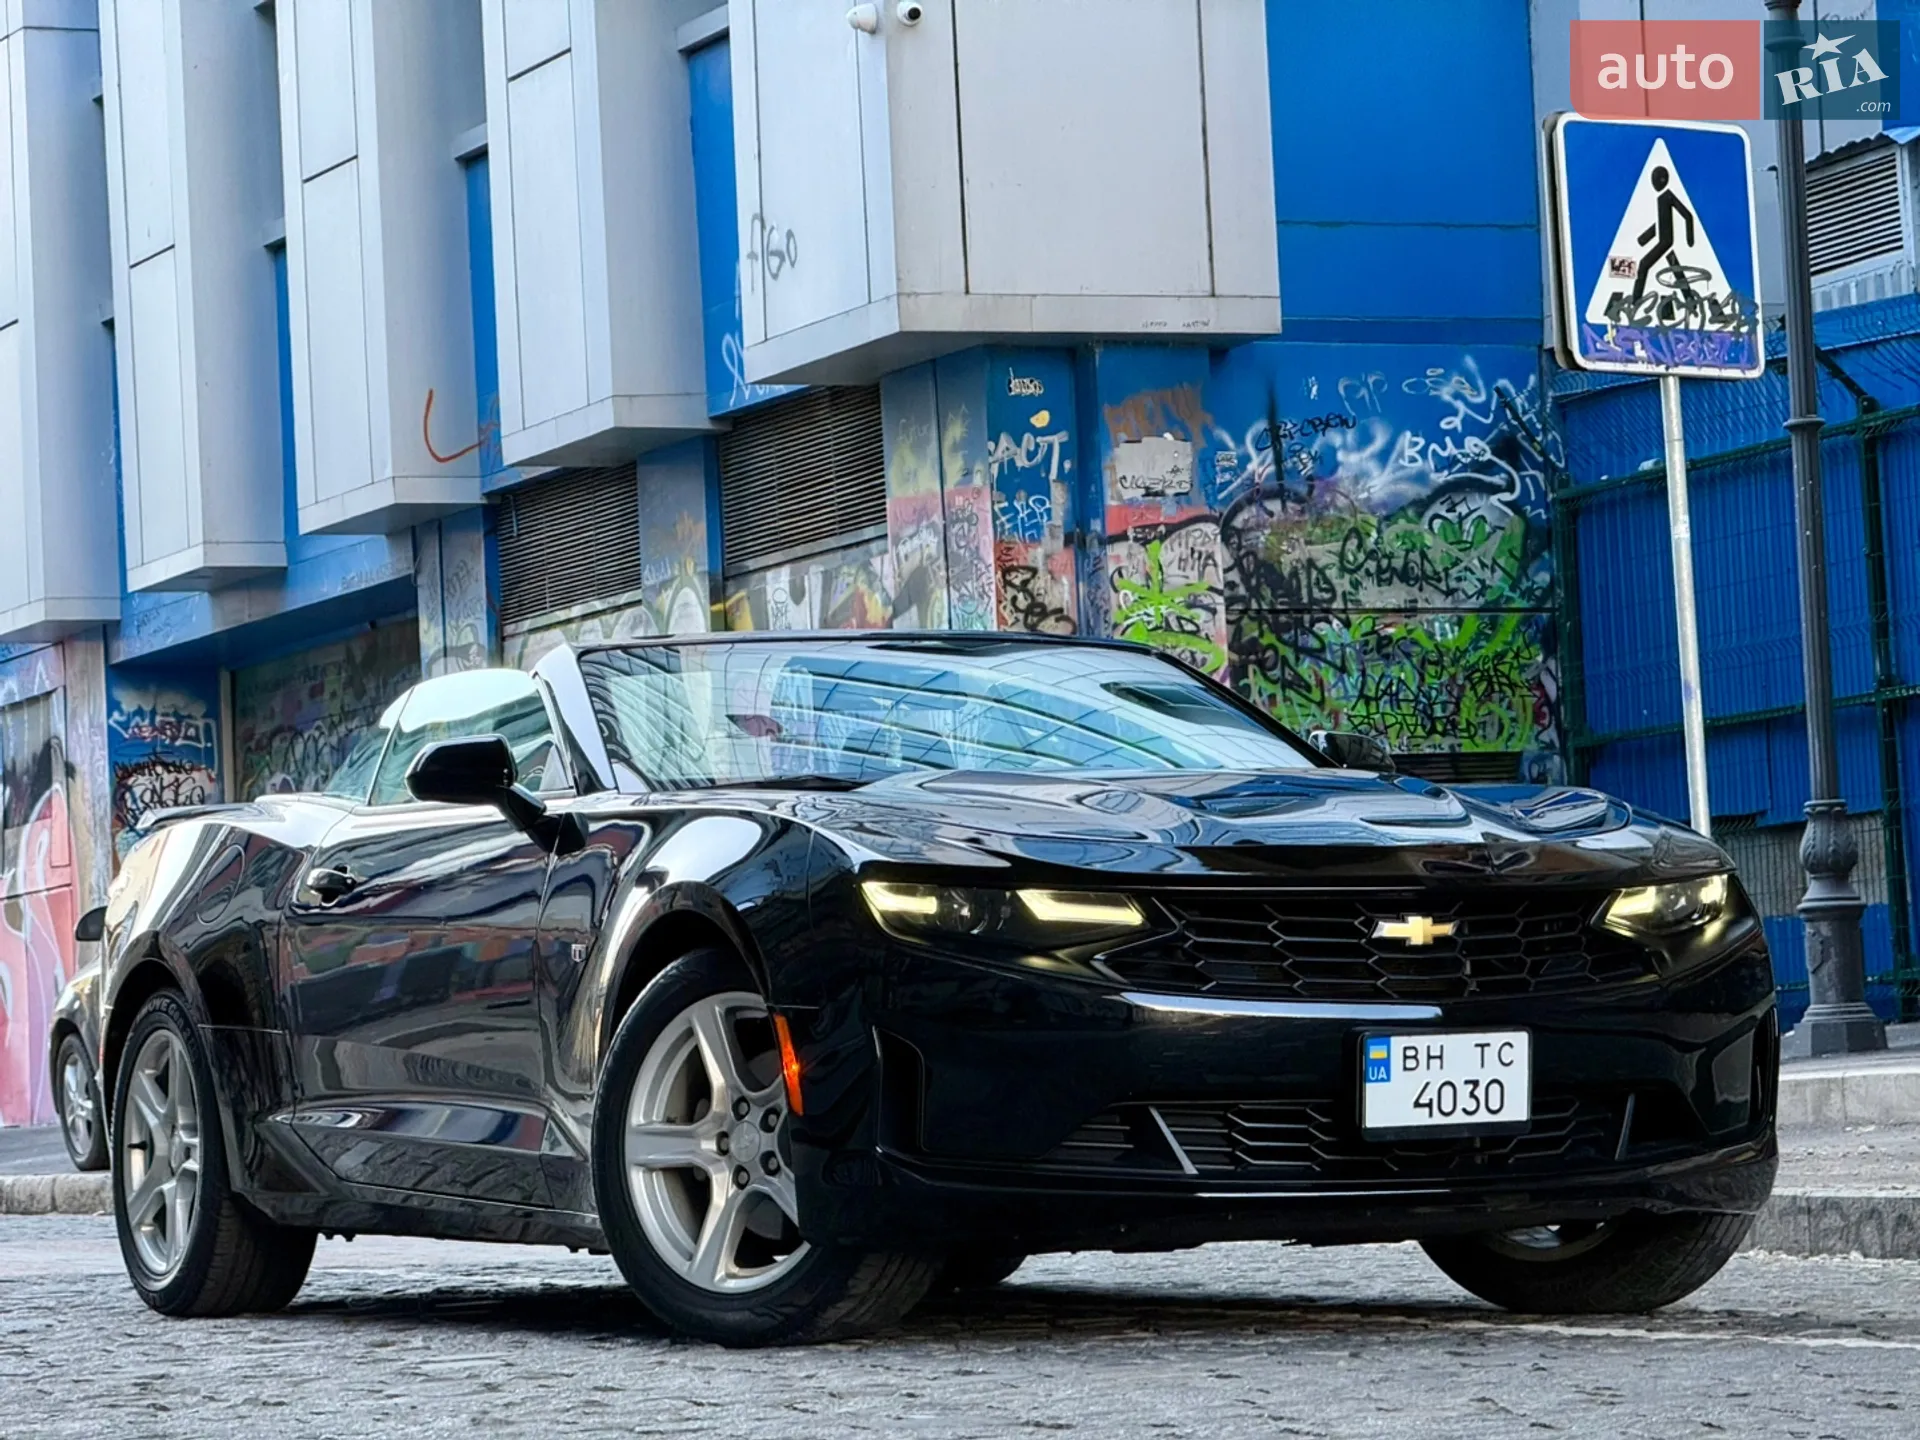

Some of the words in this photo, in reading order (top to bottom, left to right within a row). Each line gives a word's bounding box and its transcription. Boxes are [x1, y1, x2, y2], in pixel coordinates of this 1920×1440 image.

[1402, 1044, 1444, 1071] BH
[1474, 1041, 1514, 1068] TC
[1369, 1066, 1387, 1080] UA
[1413, 1078, 1505, 1118] 4030
